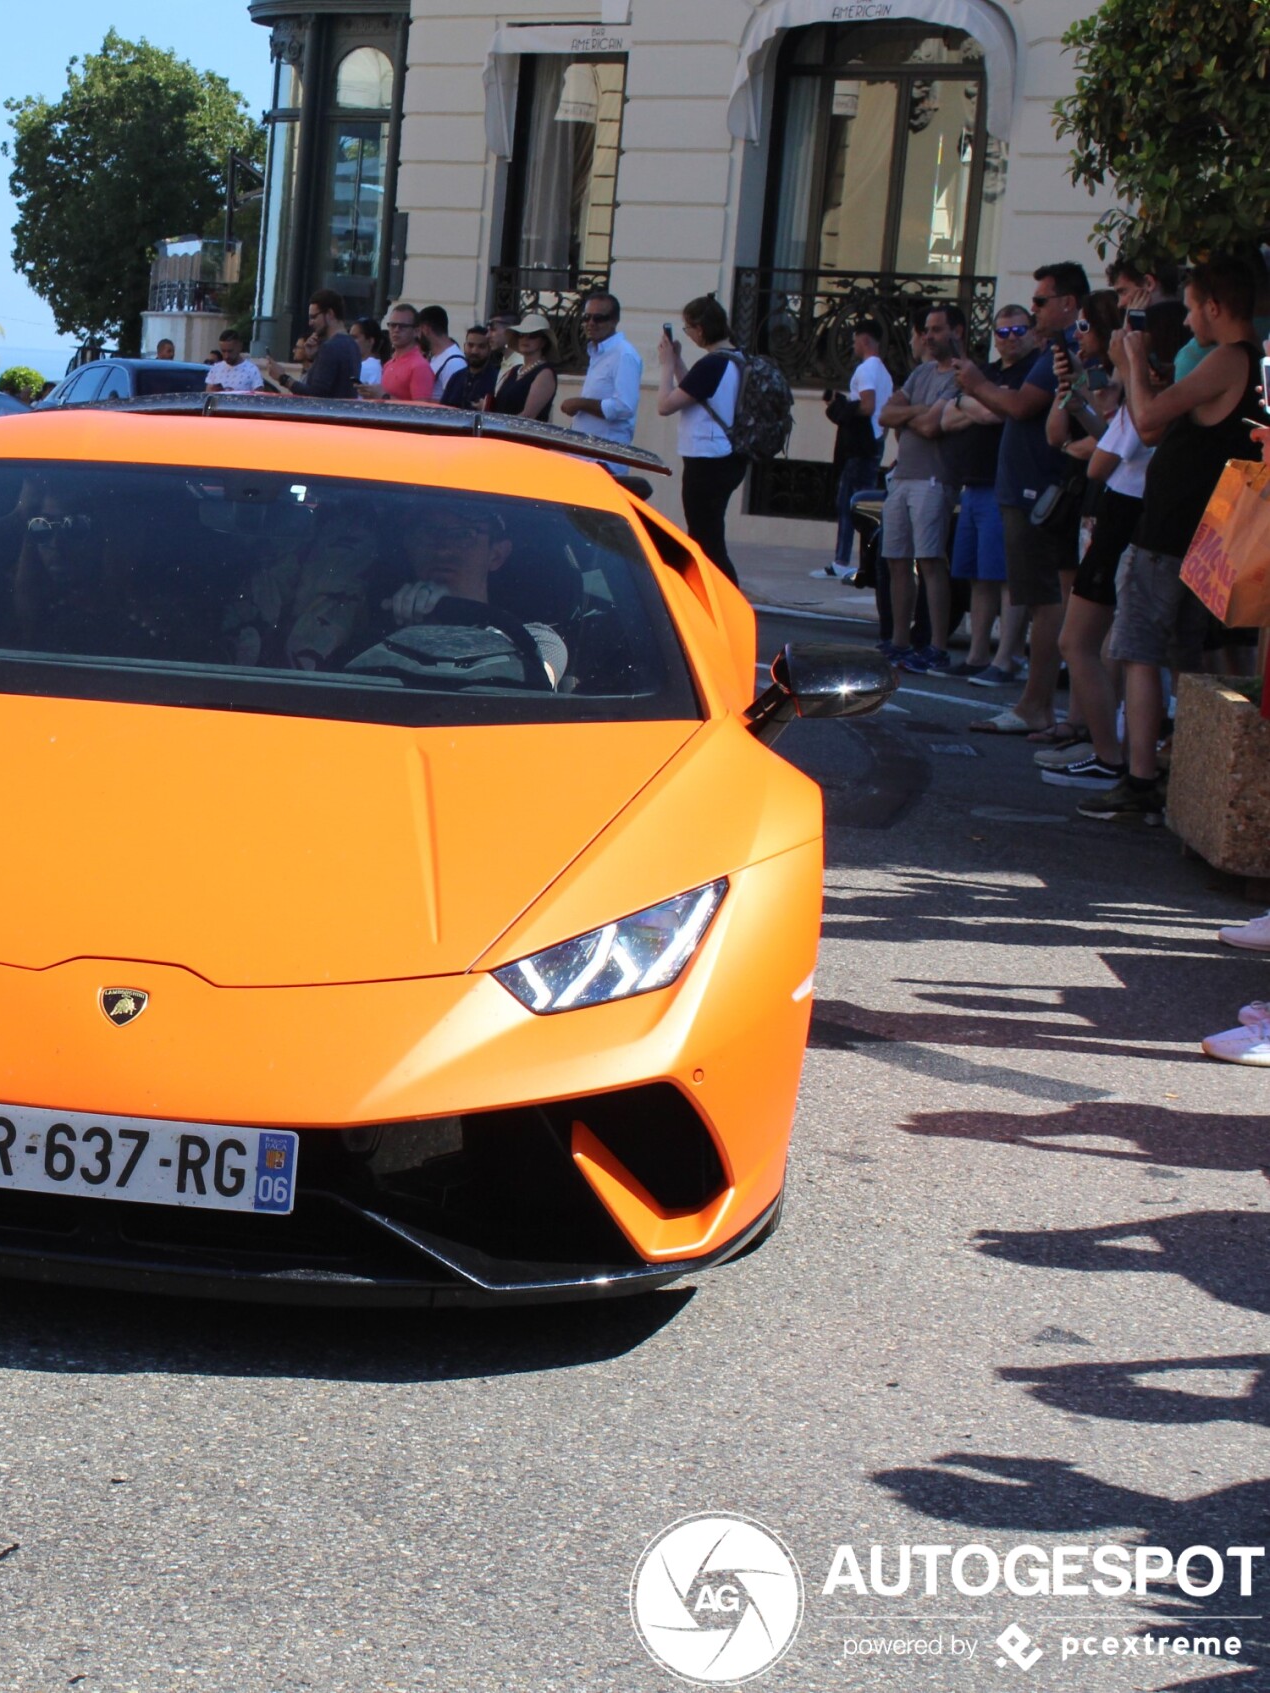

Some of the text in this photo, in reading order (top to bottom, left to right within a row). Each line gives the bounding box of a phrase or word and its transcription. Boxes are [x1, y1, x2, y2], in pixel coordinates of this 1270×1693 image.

[591, 28, 606, 36] BAR
[265, 1142, 288, 1152] PACA
[258, 1175, 289, 1203] 06
